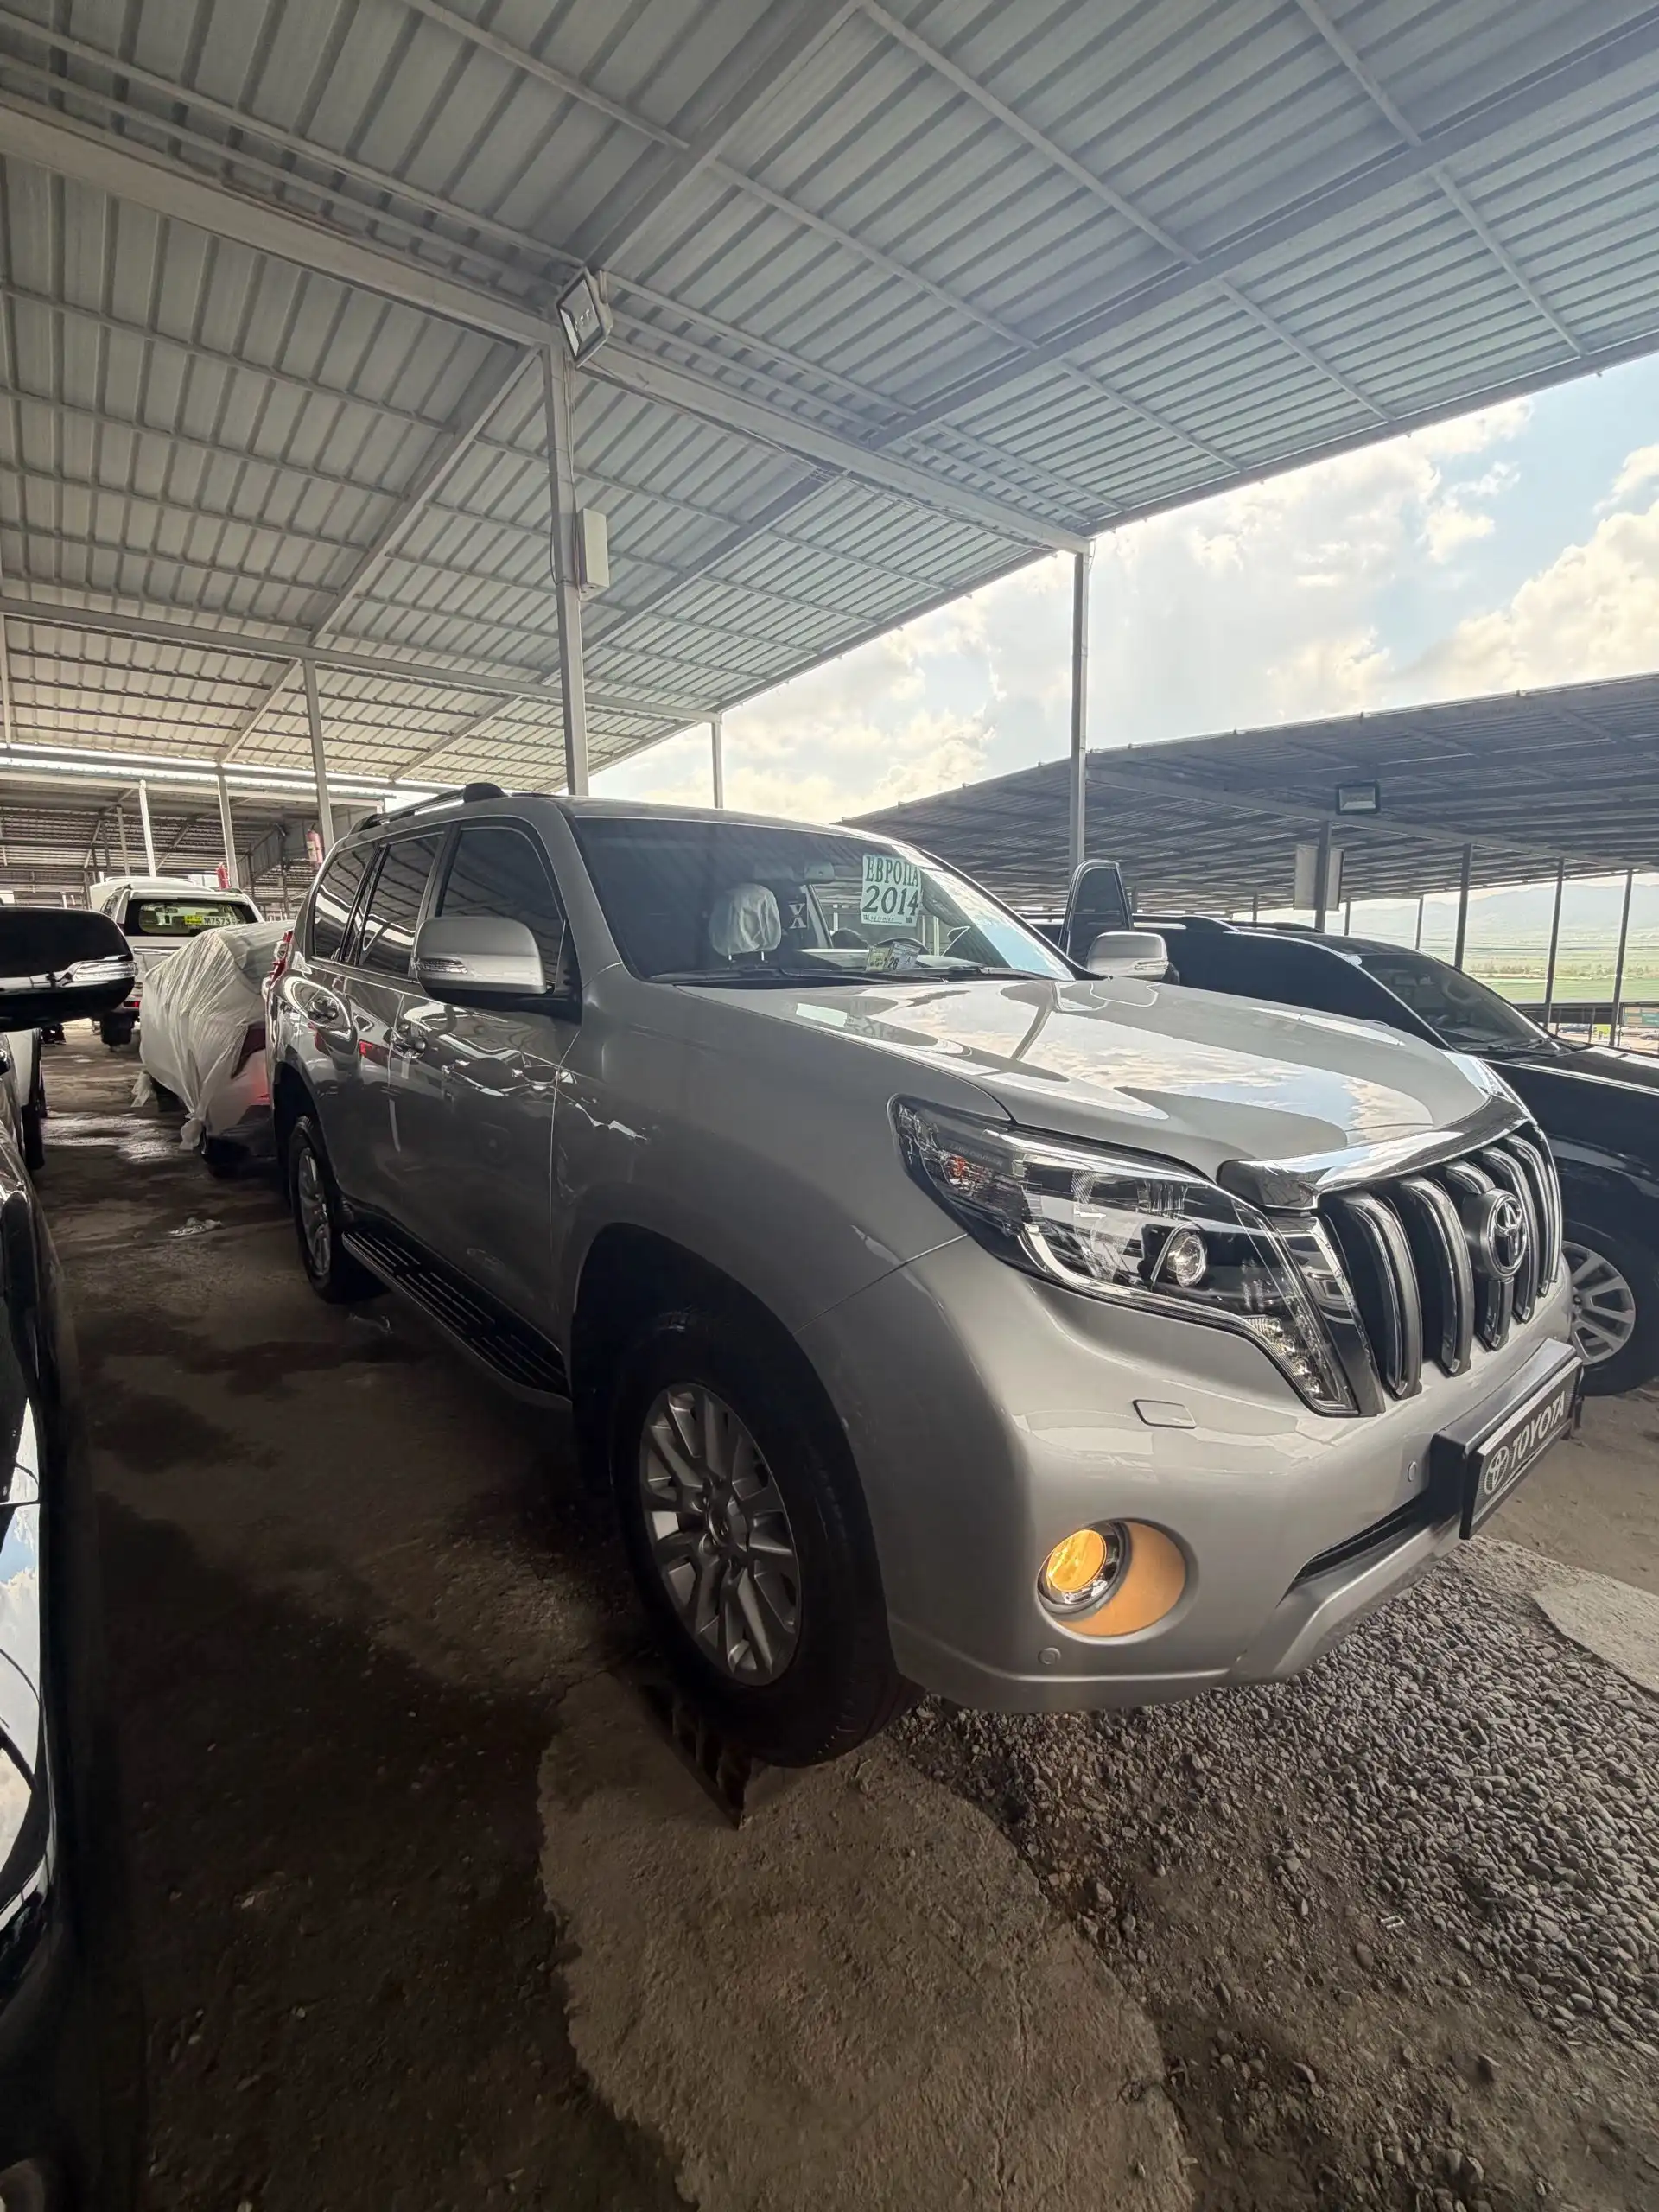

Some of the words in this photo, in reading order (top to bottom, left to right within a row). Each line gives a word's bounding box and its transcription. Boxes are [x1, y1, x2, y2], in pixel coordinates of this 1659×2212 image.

[865, 855, 919, 887] ЕВРОПА
[862, 885, 919, 916] 2014
[1510, 1390, 1565, 1469] TOYOTA
